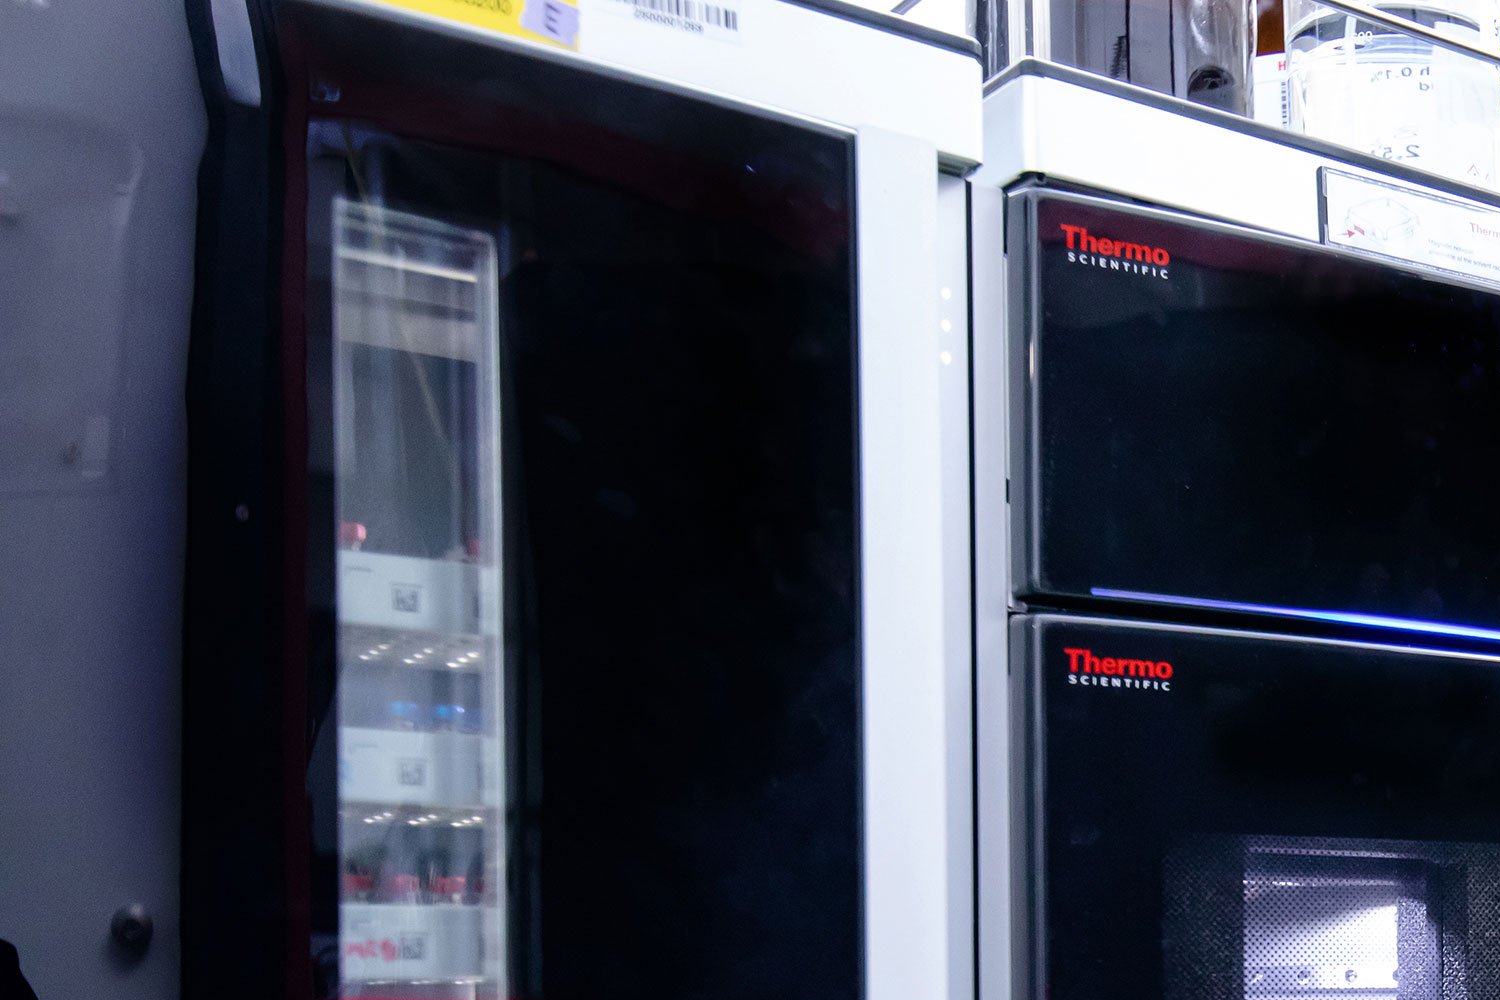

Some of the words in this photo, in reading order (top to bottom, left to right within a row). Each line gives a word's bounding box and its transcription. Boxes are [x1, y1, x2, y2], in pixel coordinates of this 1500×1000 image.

[1060, 223, 1170, 266] Thermo
[1067, 251, 1169, 279] SCIENTIFIC
[1064, 648, 1174, 679] Thermo
[1068, 674, 1171, 692] SCIENTIFIC
